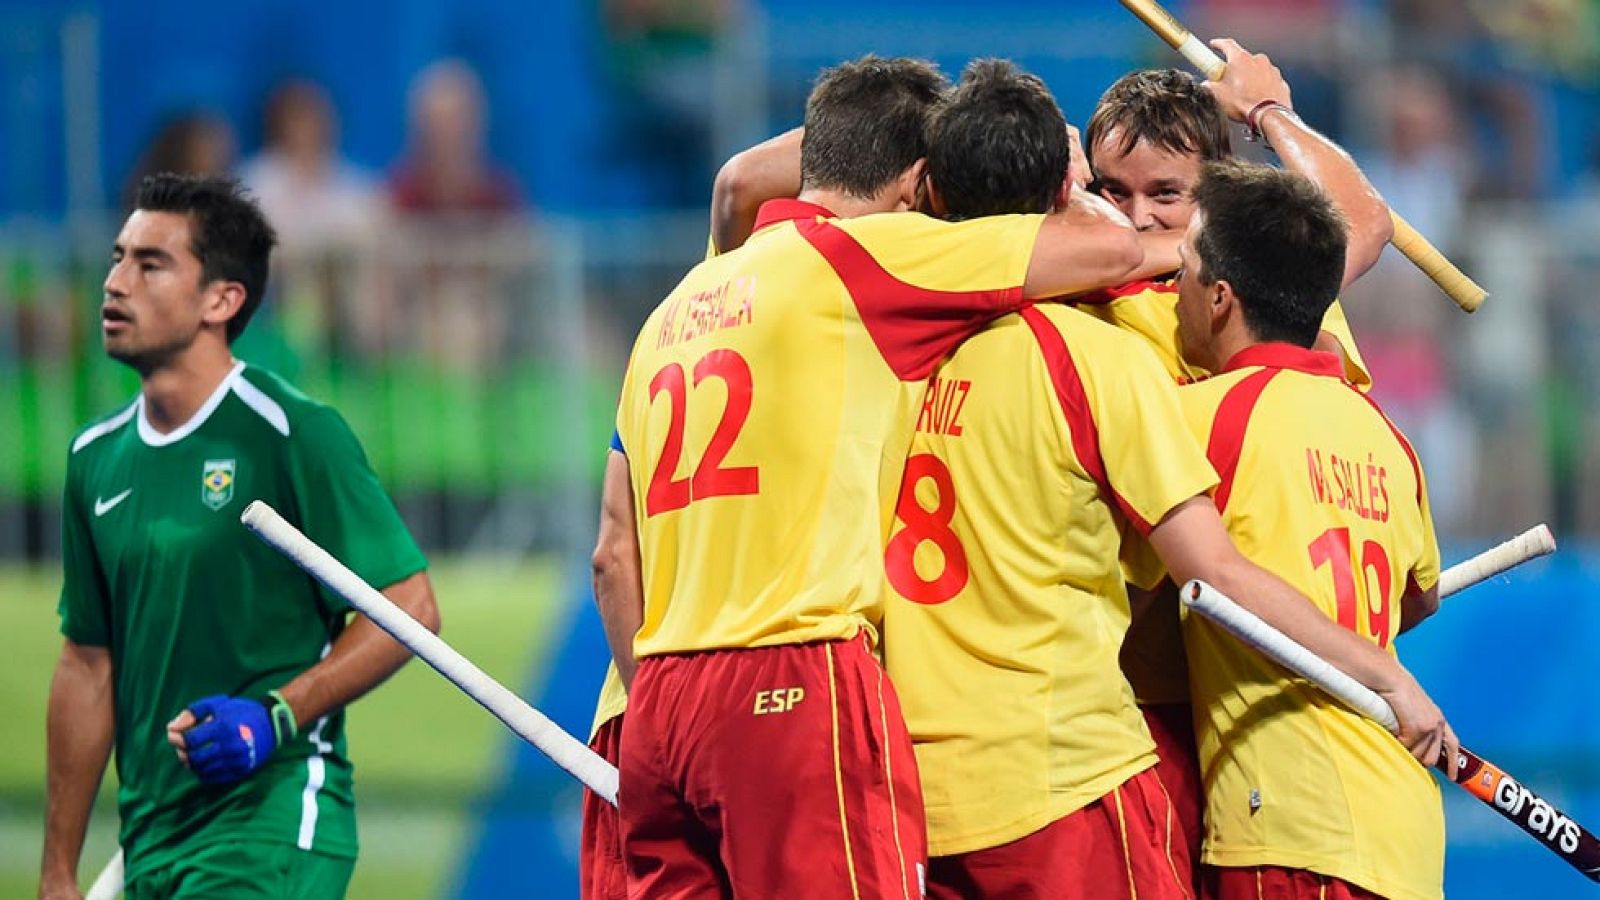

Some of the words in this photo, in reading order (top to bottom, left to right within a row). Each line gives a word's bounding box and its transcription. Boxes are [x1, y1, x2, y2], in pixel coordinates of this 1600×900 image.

[646, 348, 760, 518] 22
[915, 377, 972, 437] RUIZ
[884, 453, 969, 605] 8
[1307, 527, 1392, 650] 19
[753, 687, 805, 715] ESP
[1494, 776, 1582, 854] Grays
